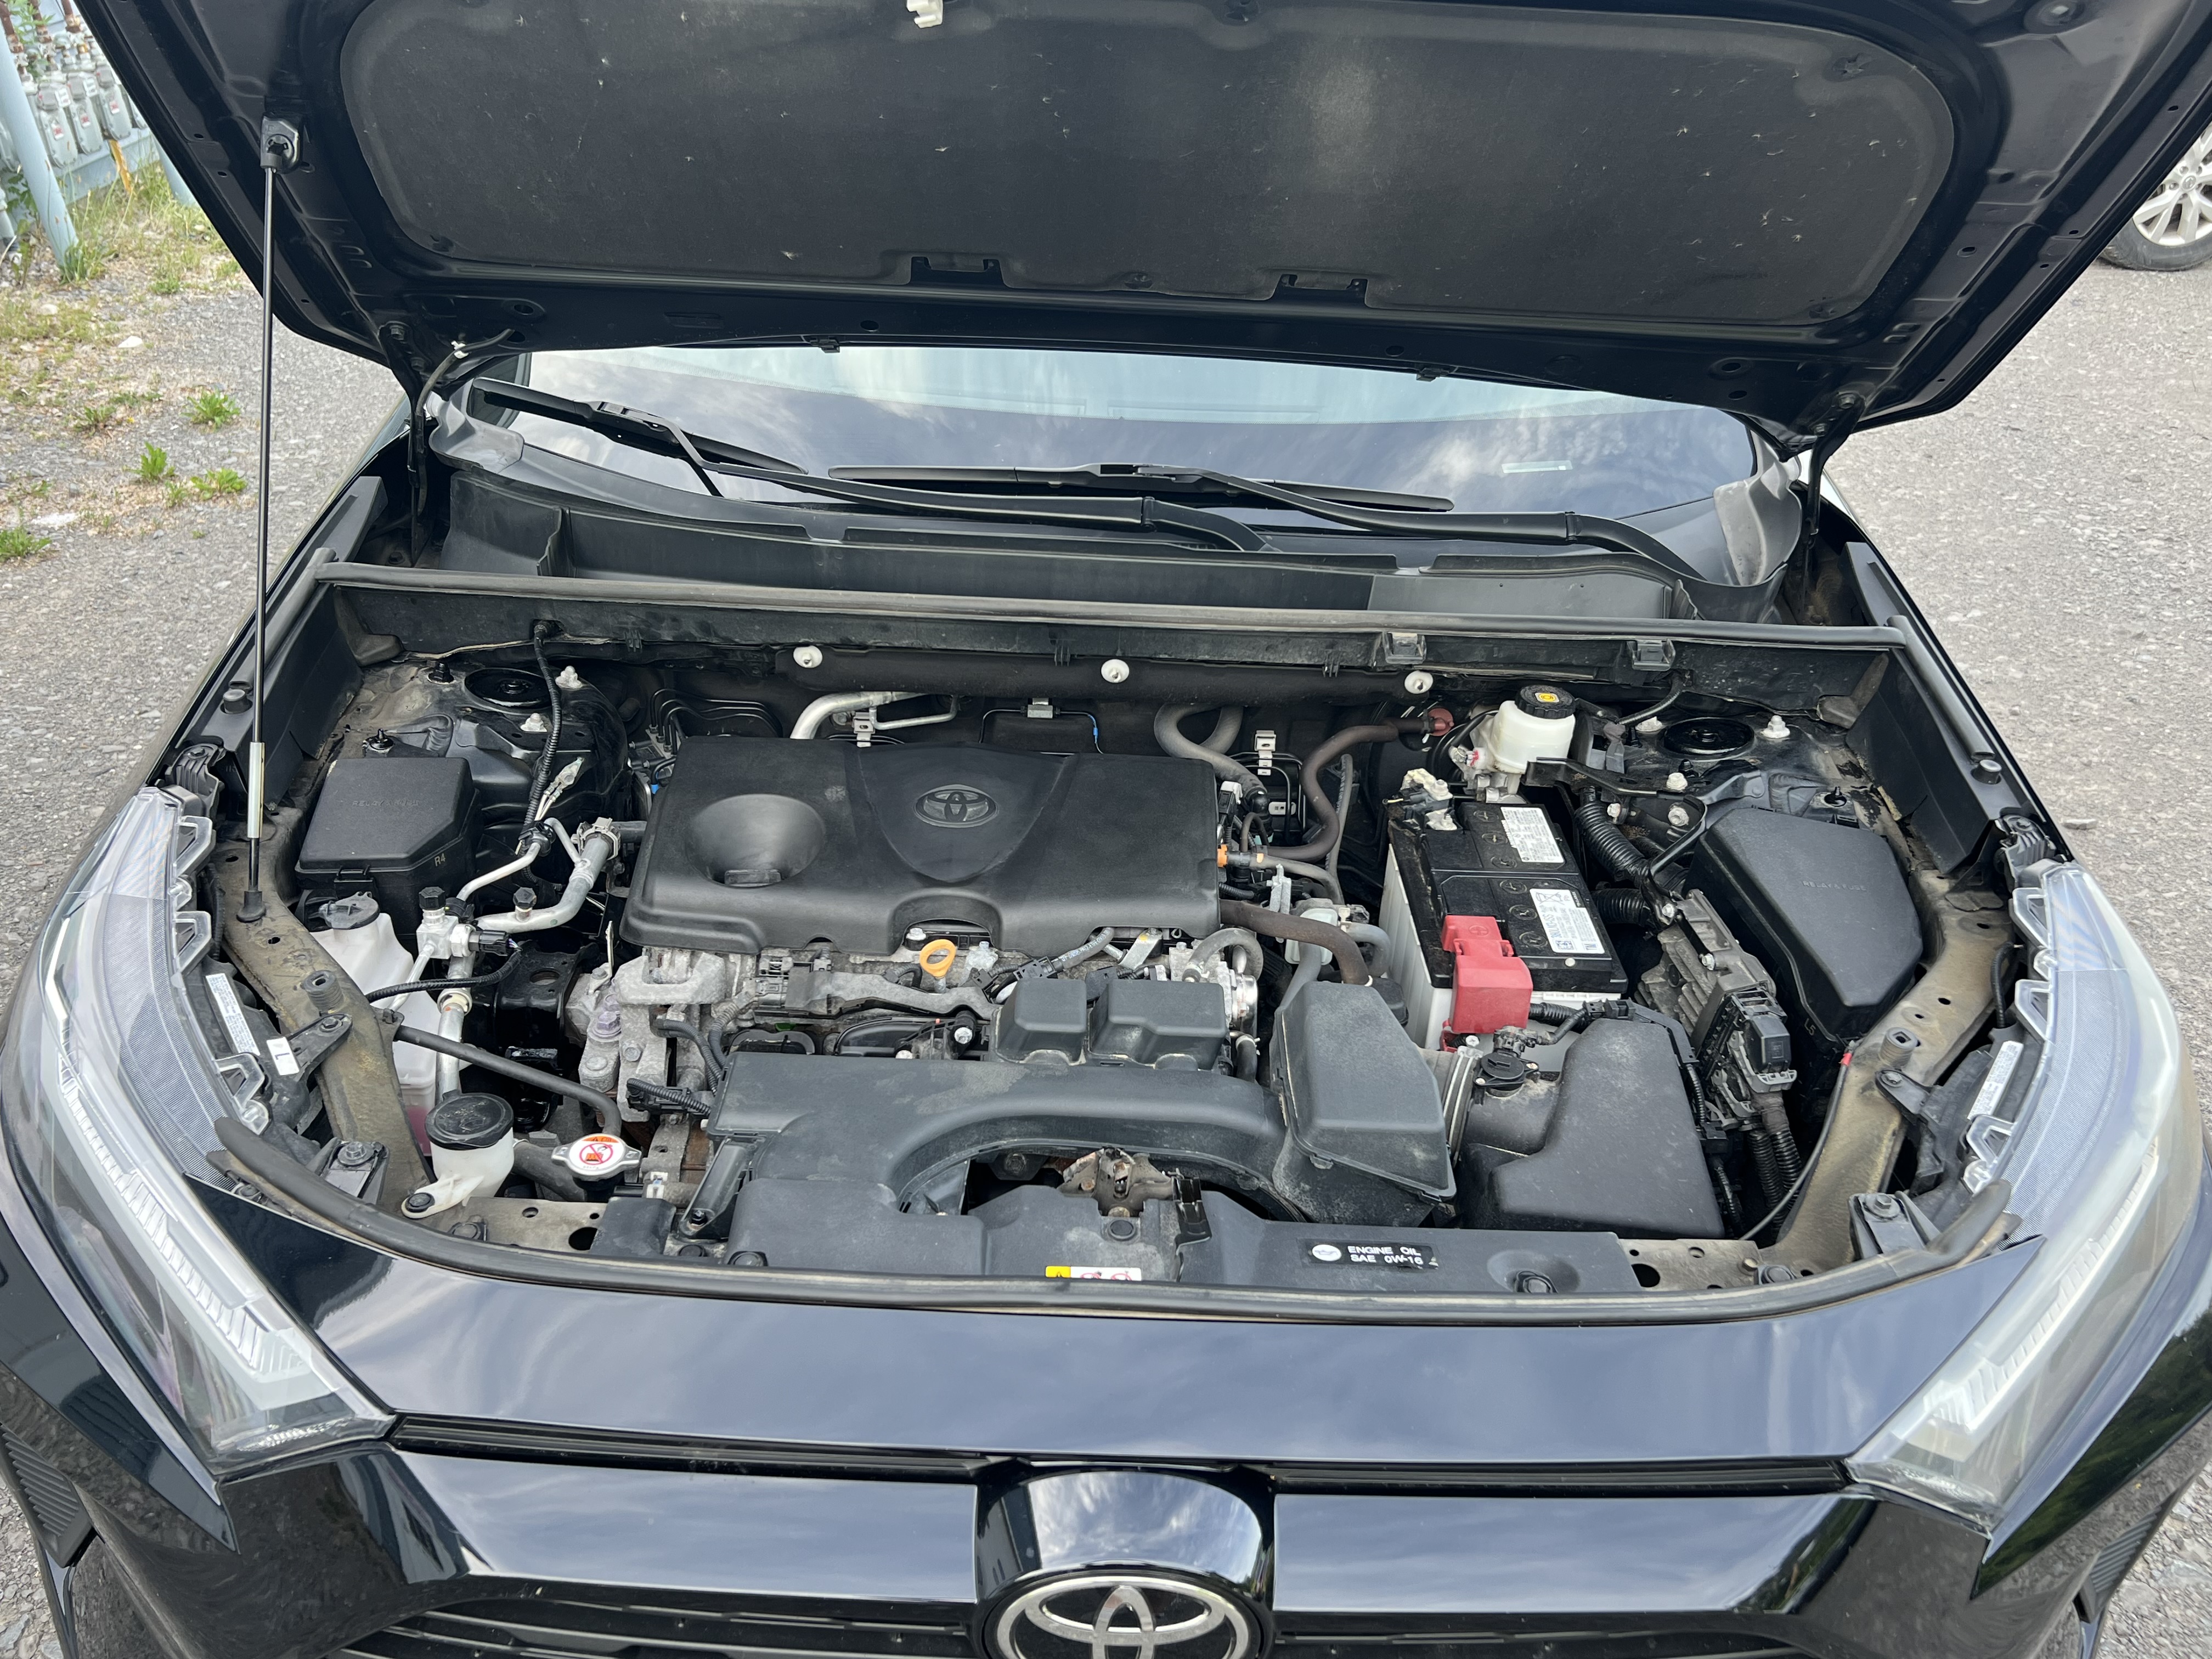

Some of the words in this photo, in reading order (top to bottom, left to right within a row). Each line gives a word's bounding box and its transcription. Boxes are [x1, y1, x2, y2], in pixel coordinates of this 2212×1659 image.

[434, 853, 446, 867] R4
[1802, 881, 1831, 889] RELAY
[1842, 884, 1867, 892] FUSE
[1804, 1018, 1816, 1036] L5
[1347, 1245, 1393, 1255] ENGINE
[1400, 1246, 1421, 1256] OIL
[1350, 1254, 1376, 1263] SAE
[1384, 1255, 1424, 1265] 0W-16
